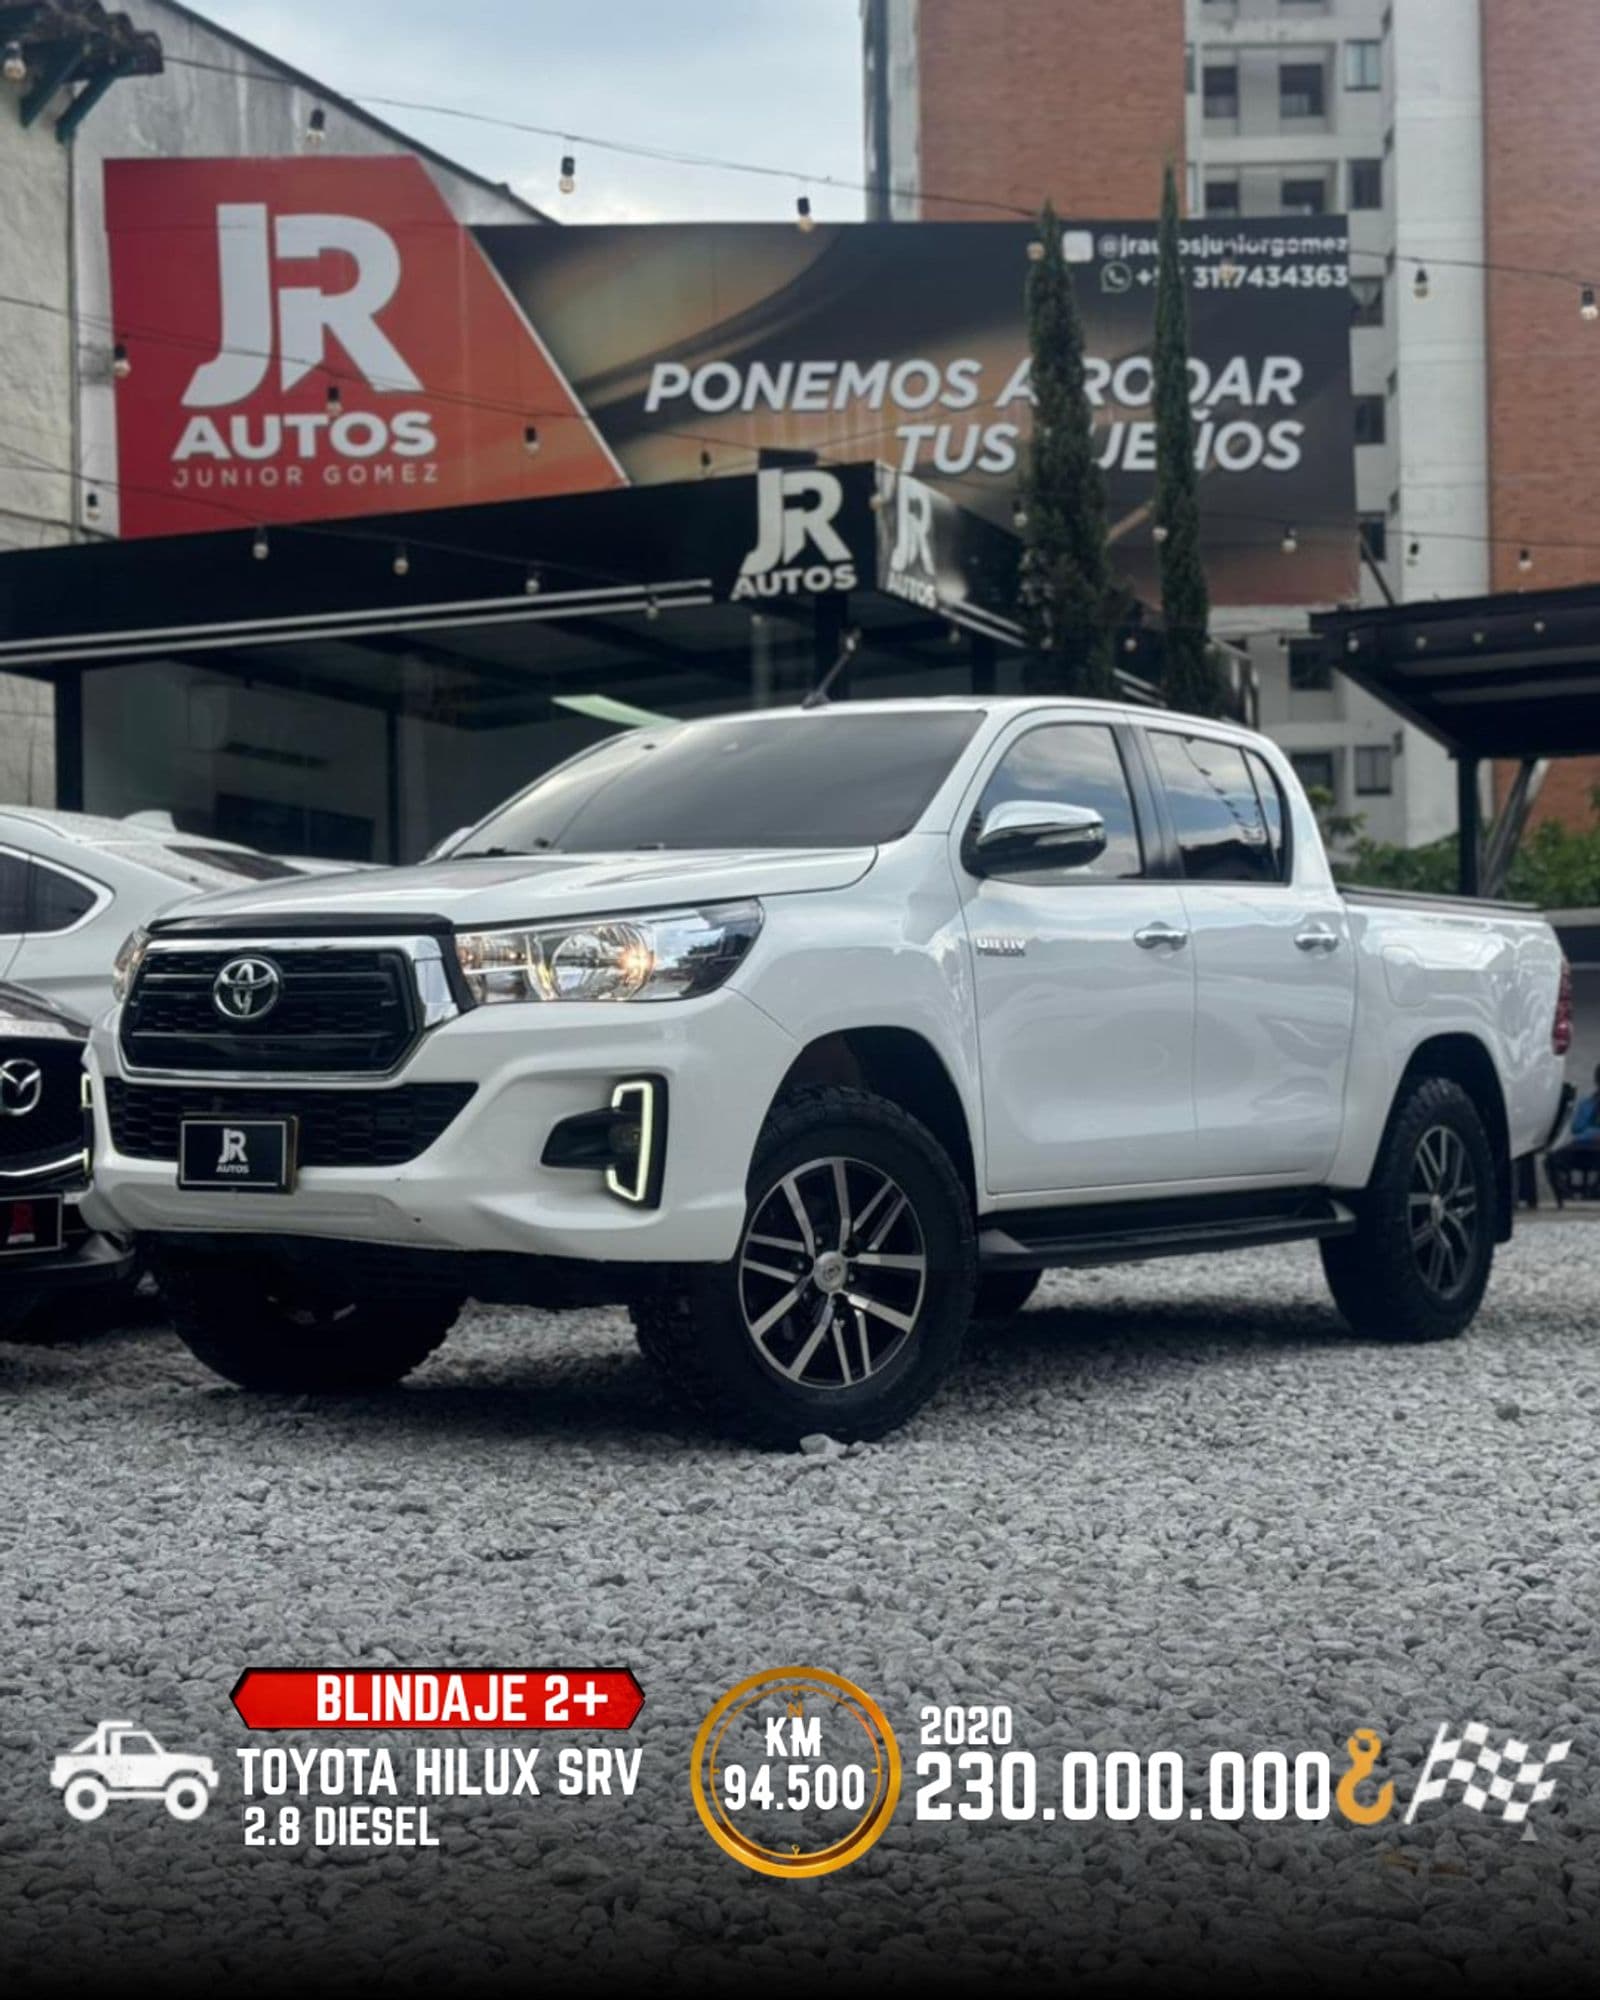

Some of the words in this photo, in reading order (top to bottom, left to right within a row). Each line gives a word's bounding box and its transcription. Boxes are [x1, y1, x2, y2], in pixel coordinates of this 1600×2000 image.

[1099, 234, 1348, 258] @jrauosjuniorgomez
[181, 203, 424, 408] JR
[644, 359, 982, 413] PONEMOS
[994, 357, 1039, 406] A
[1082, 356, 1303, 406] RODAR
[171, 411, 437, 461] AUTOS
[896, 422, 1019, 474] TUS
[1090, 409, 1305, 471] UEOS
[173, 462, 304, 489] JUNIOR
[324, 463, 439, 485] GOMEZ
[740, 468, 853, 575] JR
[731, 564, 857, 601] AUTOS
[218, 1128, 249, 1163] JR
